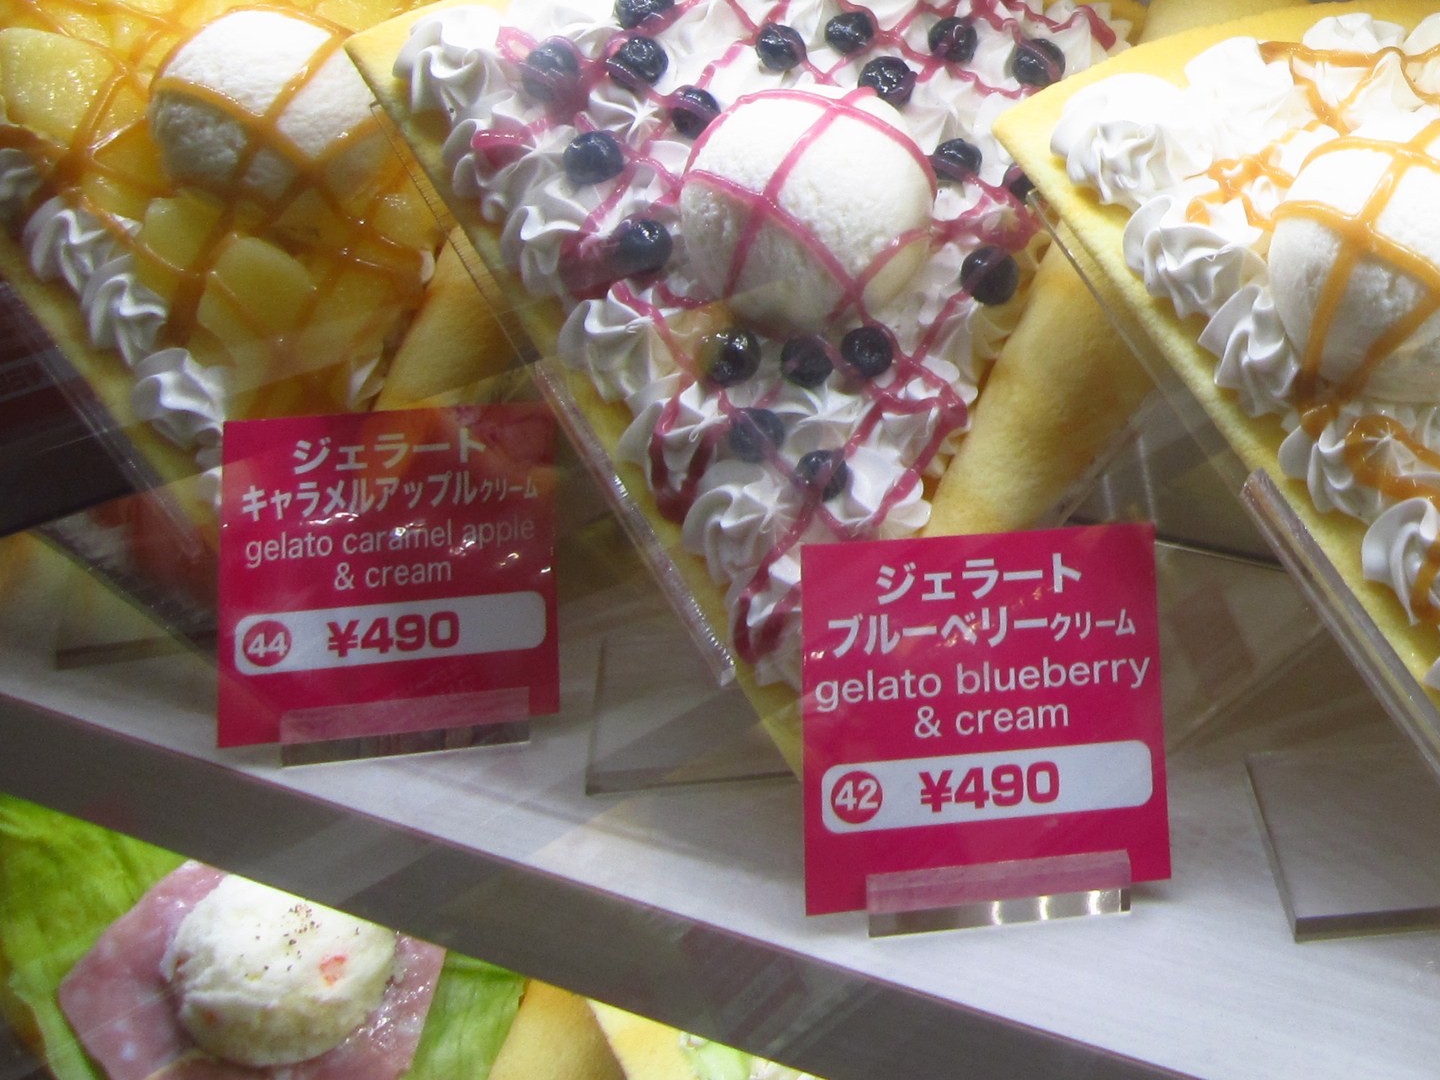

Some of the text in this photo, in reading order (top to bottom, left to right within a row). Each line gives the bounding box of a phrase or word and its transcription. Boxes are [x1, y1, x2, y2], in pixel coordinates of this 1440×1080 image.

[293, 427, 487, 475] ジェラート
[241, 471, 538, 521] キャラメルアップルクリーム
[245, 517, 535, 568] gelato caramel apple
[334, 561, 452, 591] & cream
[876, 553, 1082, 604] ジェラート
[247, 610, 460, 658] 44 ¥490
[827, 606, 1136, 658] ブルーベリークリーム
[816, 656, 1151, 712] gelato blueberry
[914, 703, 1069, 738] & cream
[835, 761, 1060, 813] 42 ¥490
